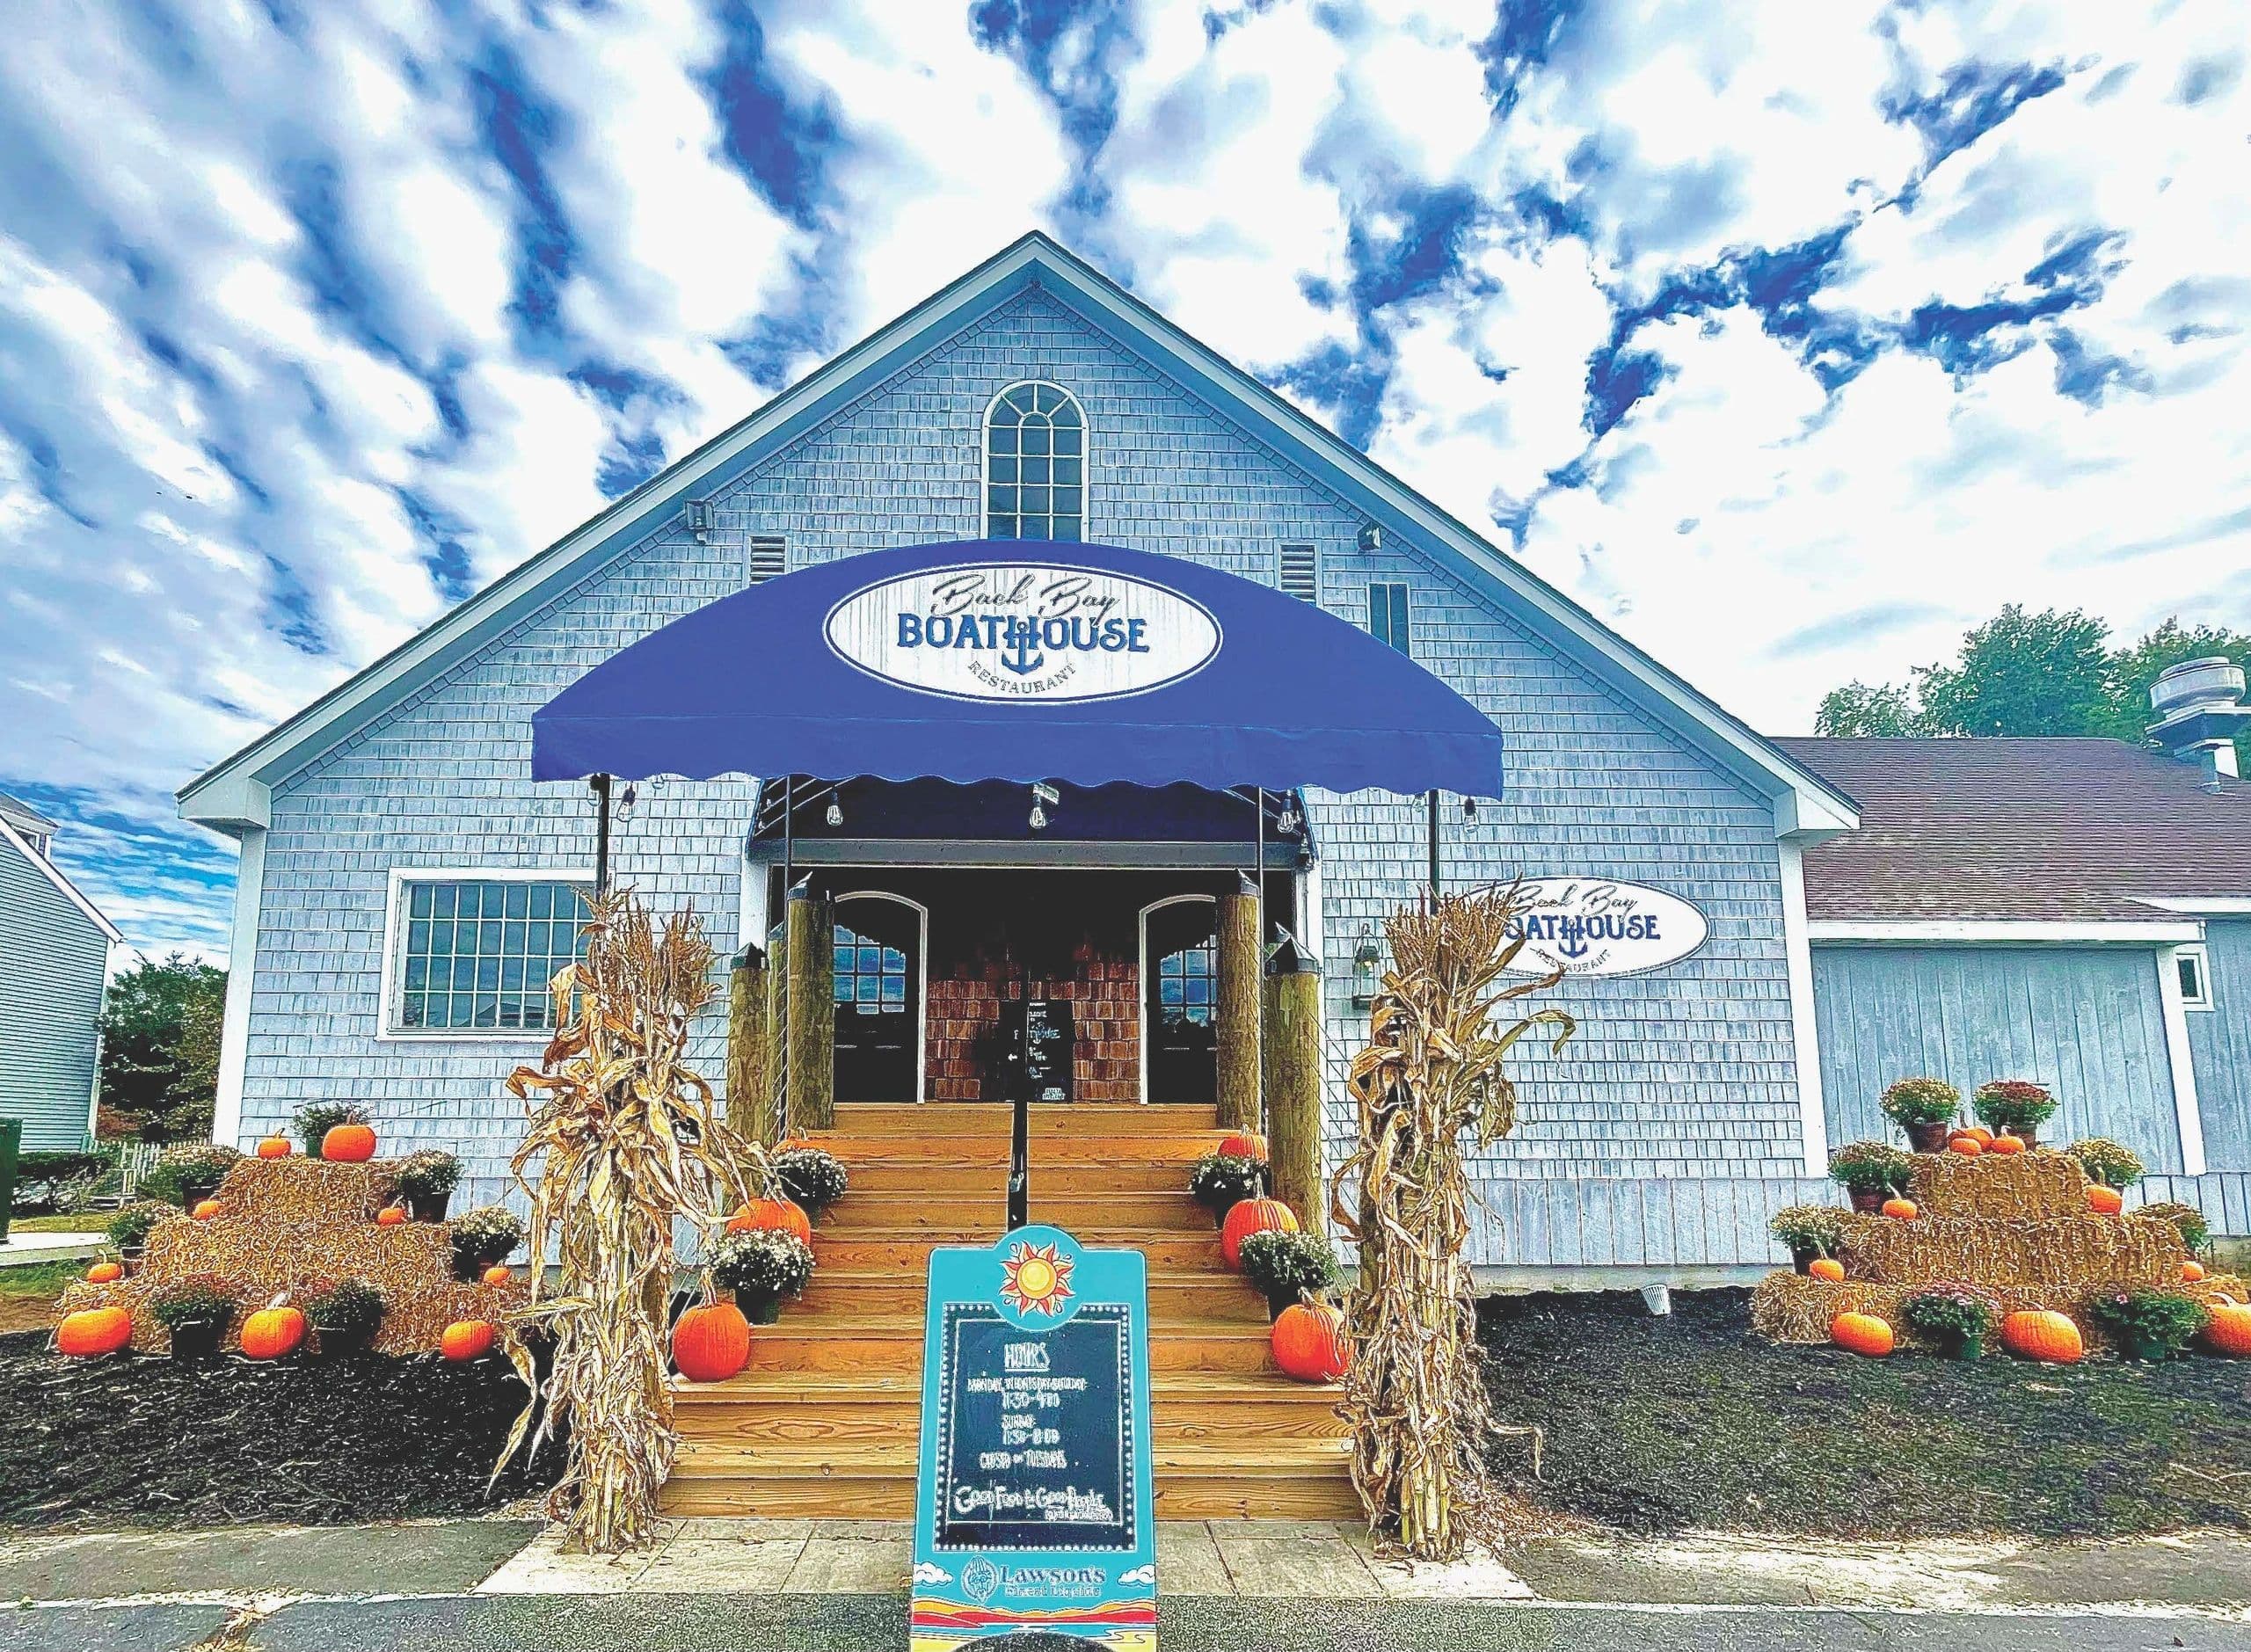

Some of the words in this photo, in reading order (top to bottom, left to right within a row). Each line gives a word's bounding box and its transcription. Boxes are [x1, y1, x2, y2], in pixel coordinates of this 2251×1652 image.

[930, 572, 1036, 616] Back
[1038, 576, 1120, 626] Bay
[896, 613, 1151, 654] BOATHOUSE
[967, 660, 1077, 695] RESTAURANT
[1581, 884, 1638, 923] Bay
[1504, 914, 1661, 941] OATHOUSE
[1004, 1342, 1051, 1369] HOURS
[1001, 1565, 1105, 1584] Lawson's
